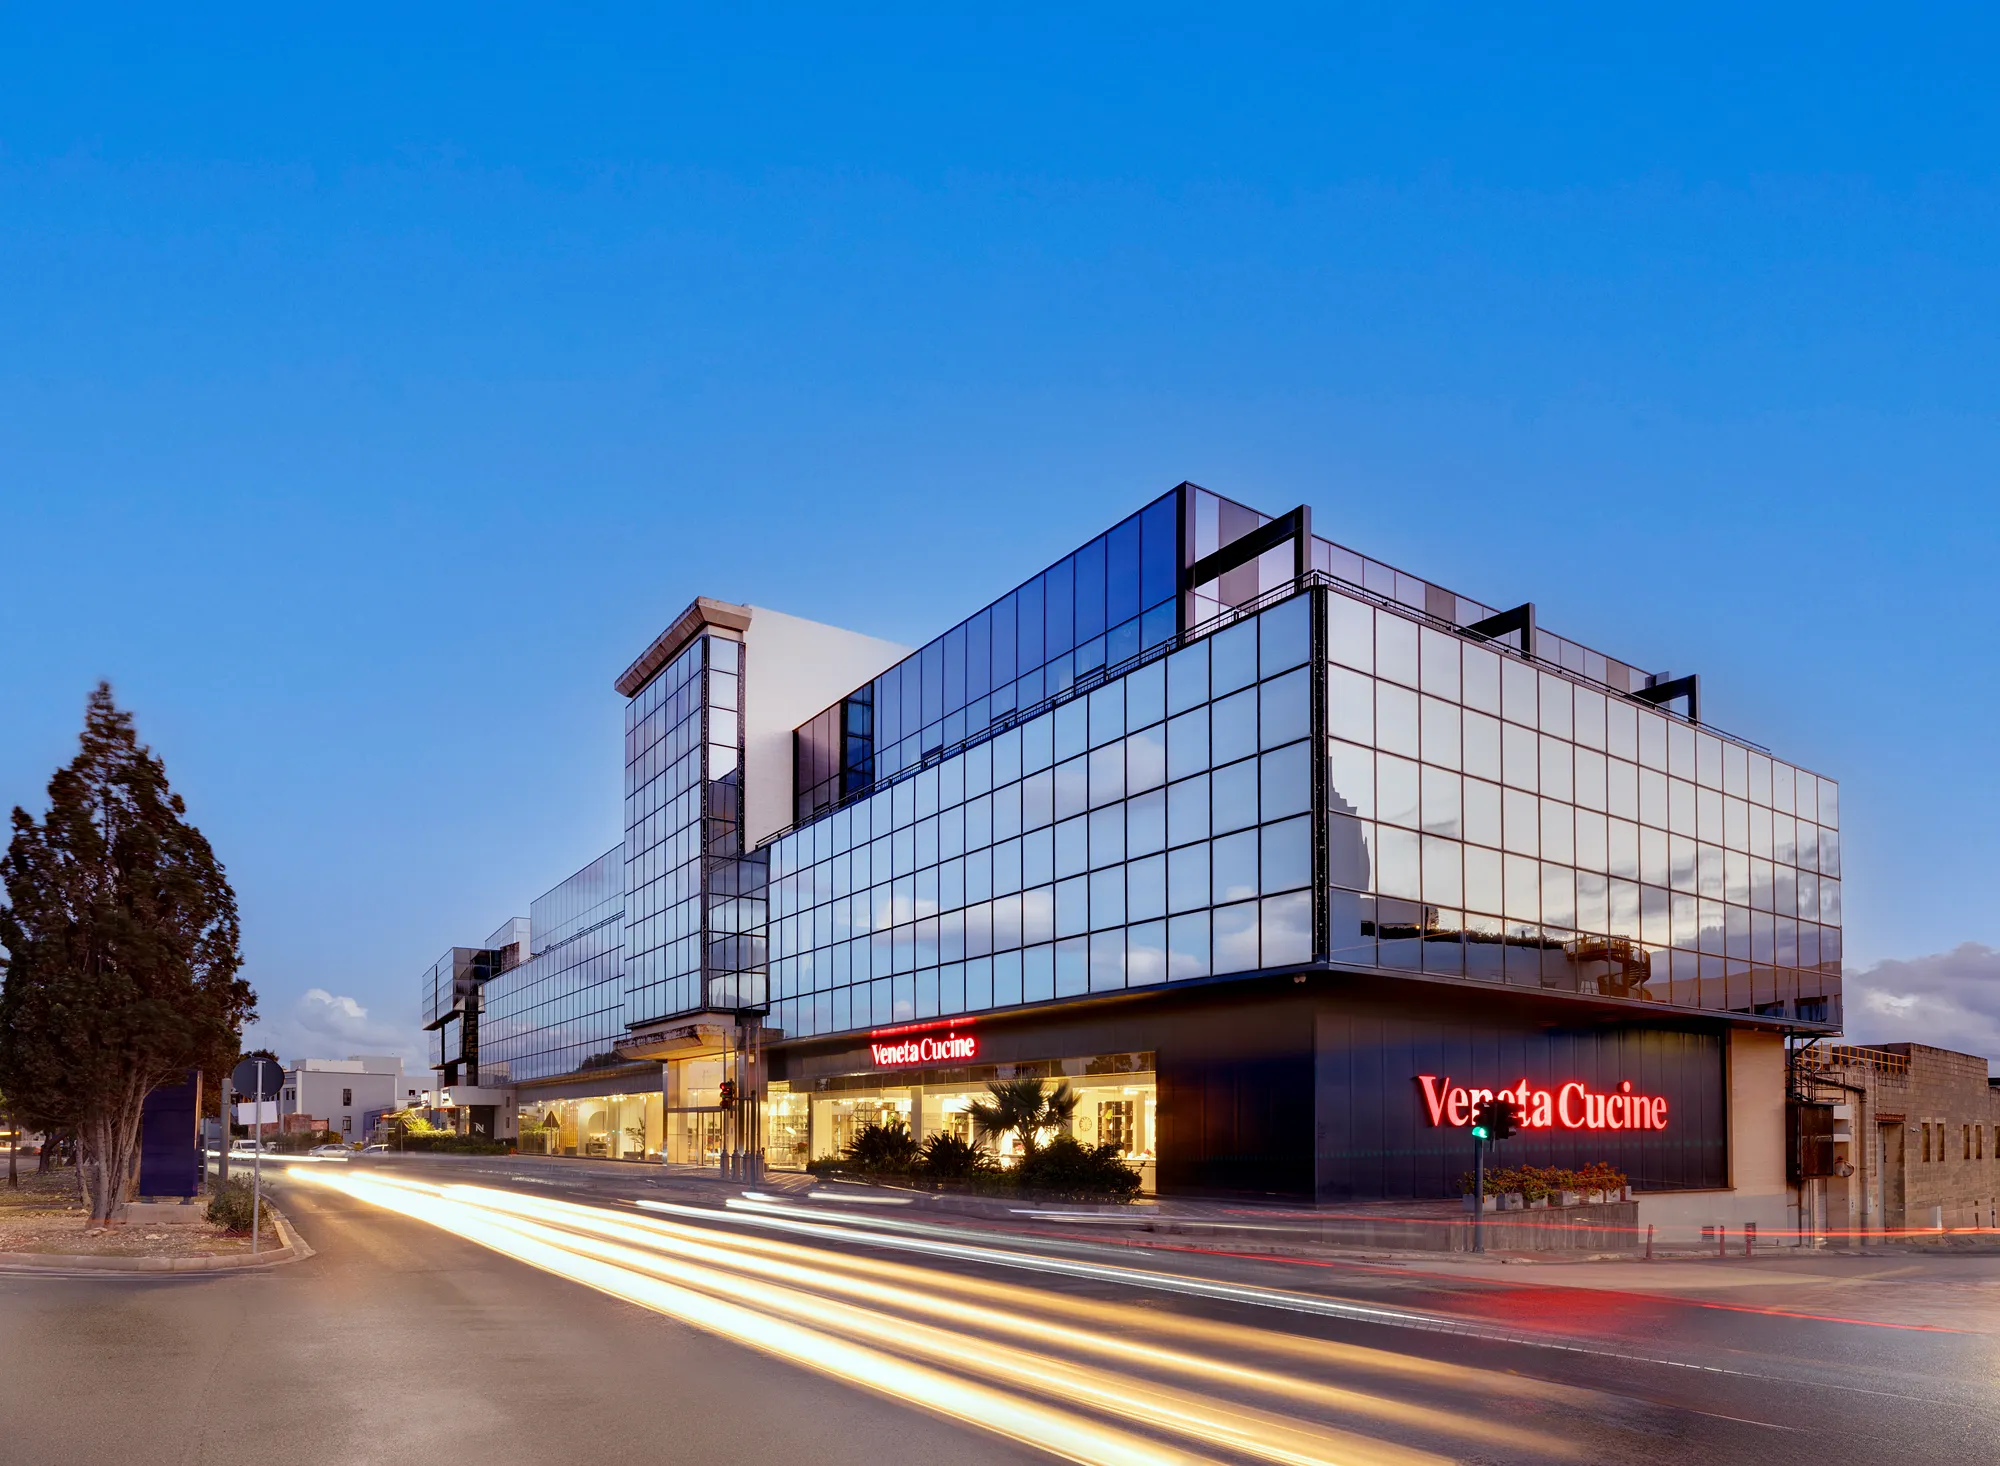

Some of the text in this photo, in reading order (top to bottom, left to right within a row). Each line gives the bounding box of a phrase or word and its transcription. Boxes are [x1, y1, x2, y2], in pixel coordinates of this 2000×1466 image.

[871, 1032, 975, 1065] Veneta Cucine
[1558, 1081, 1668, 1130] Cucine
